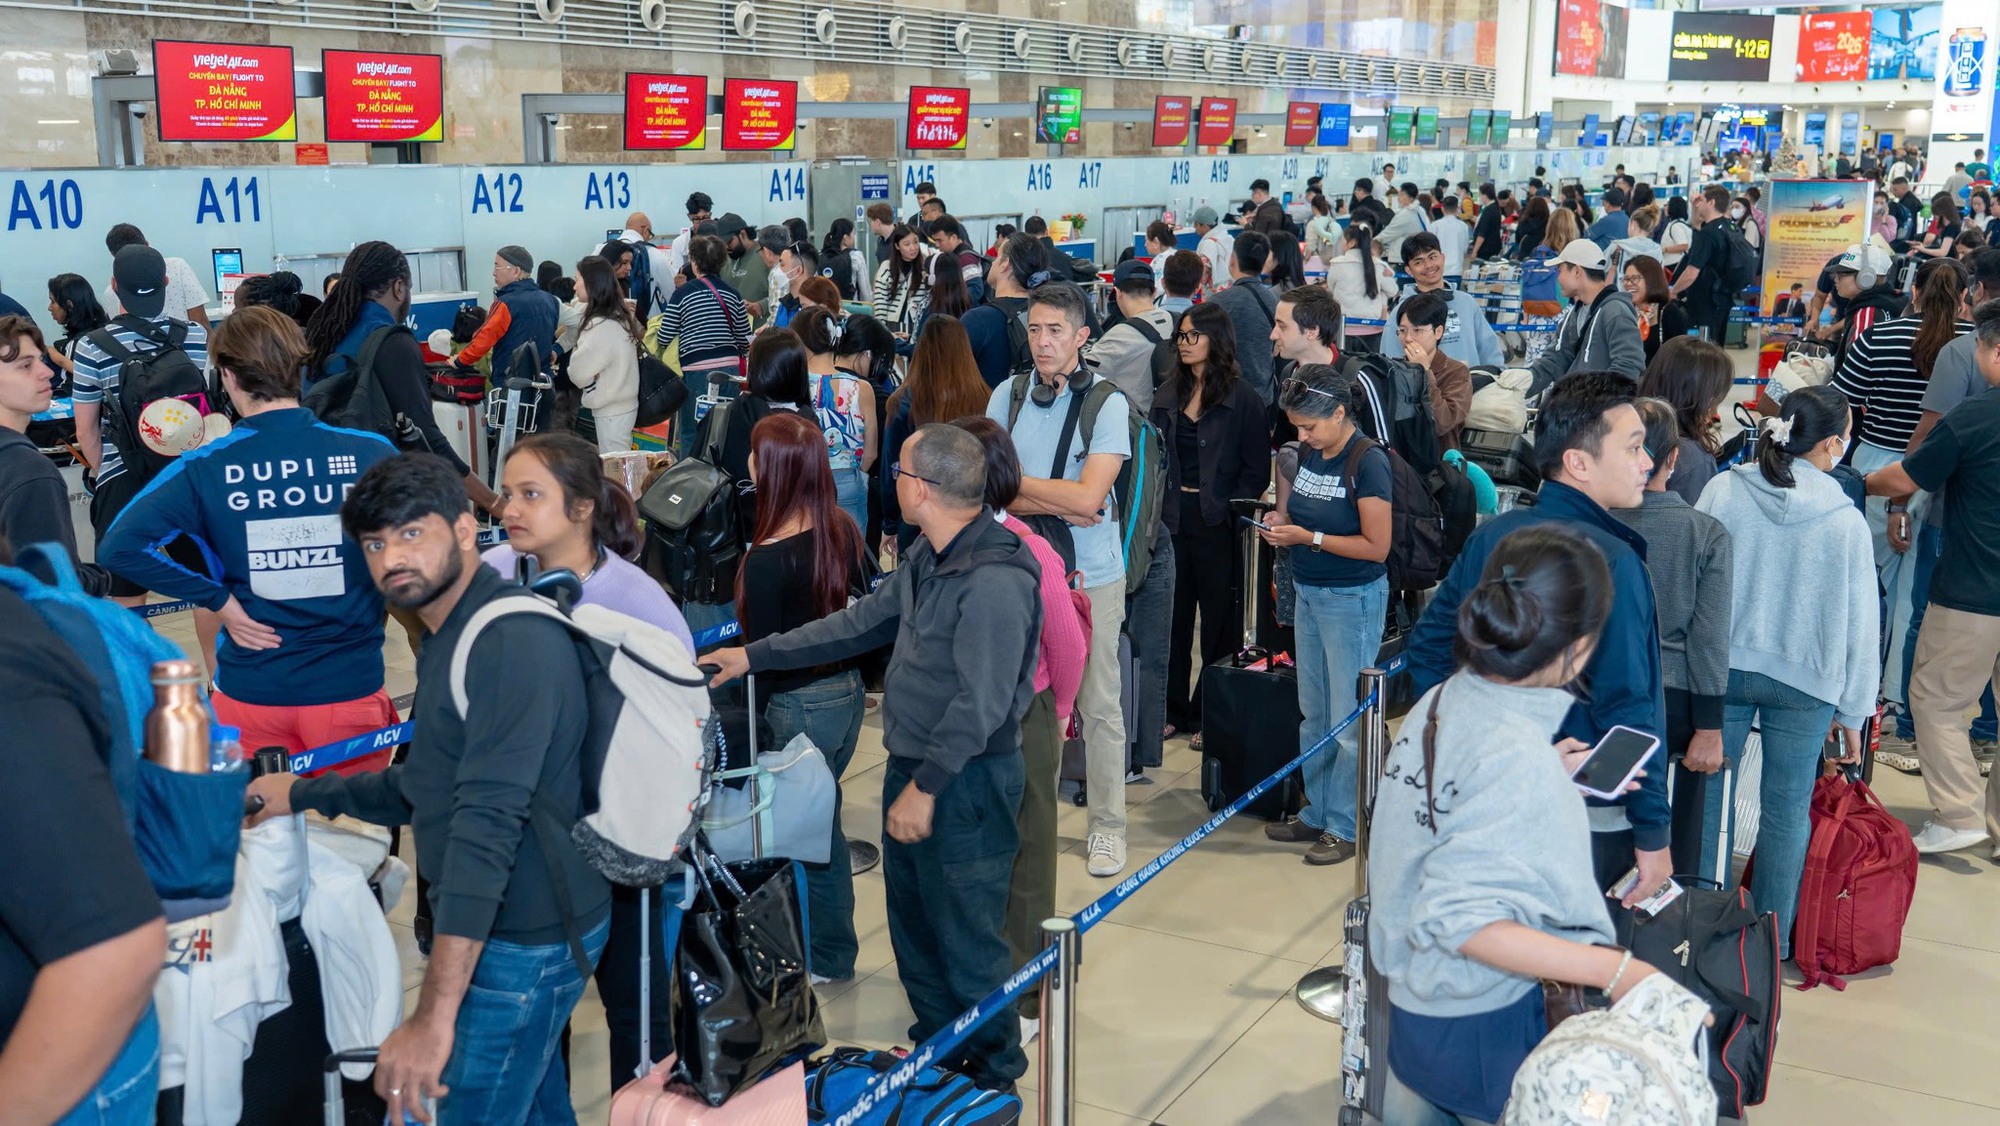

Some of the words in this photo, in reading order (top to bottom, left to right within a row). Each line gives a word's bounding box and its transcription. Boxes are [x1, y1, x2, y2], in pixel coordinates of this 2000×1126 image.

[1735, 39, 1756, 58] 1-12
[1837, 32, 1862, 54] 2026
[905, 165, 934, 195] A15
[1027, 163, 1051, 191] A16
[1079, 162, 1101, 188] A17
[1170, 161, 1189, 185] A18
[1211, 160, 1228, 183] A19
[1282, 158, 1298, 179] A20
[472, 173, 524, 214] A12
[585, 172, 630, 210] A13
[769, 168, 805, 202] A14
[8, 179, 82, 230] A10
[196, 176, 260, 224] A11
[225, 458, 314, 484] DUPI
[248, 547, 344, 569] BUNZL
[720, 622, 738, 637] ACV
[373, 727, 402, 747] ACV
